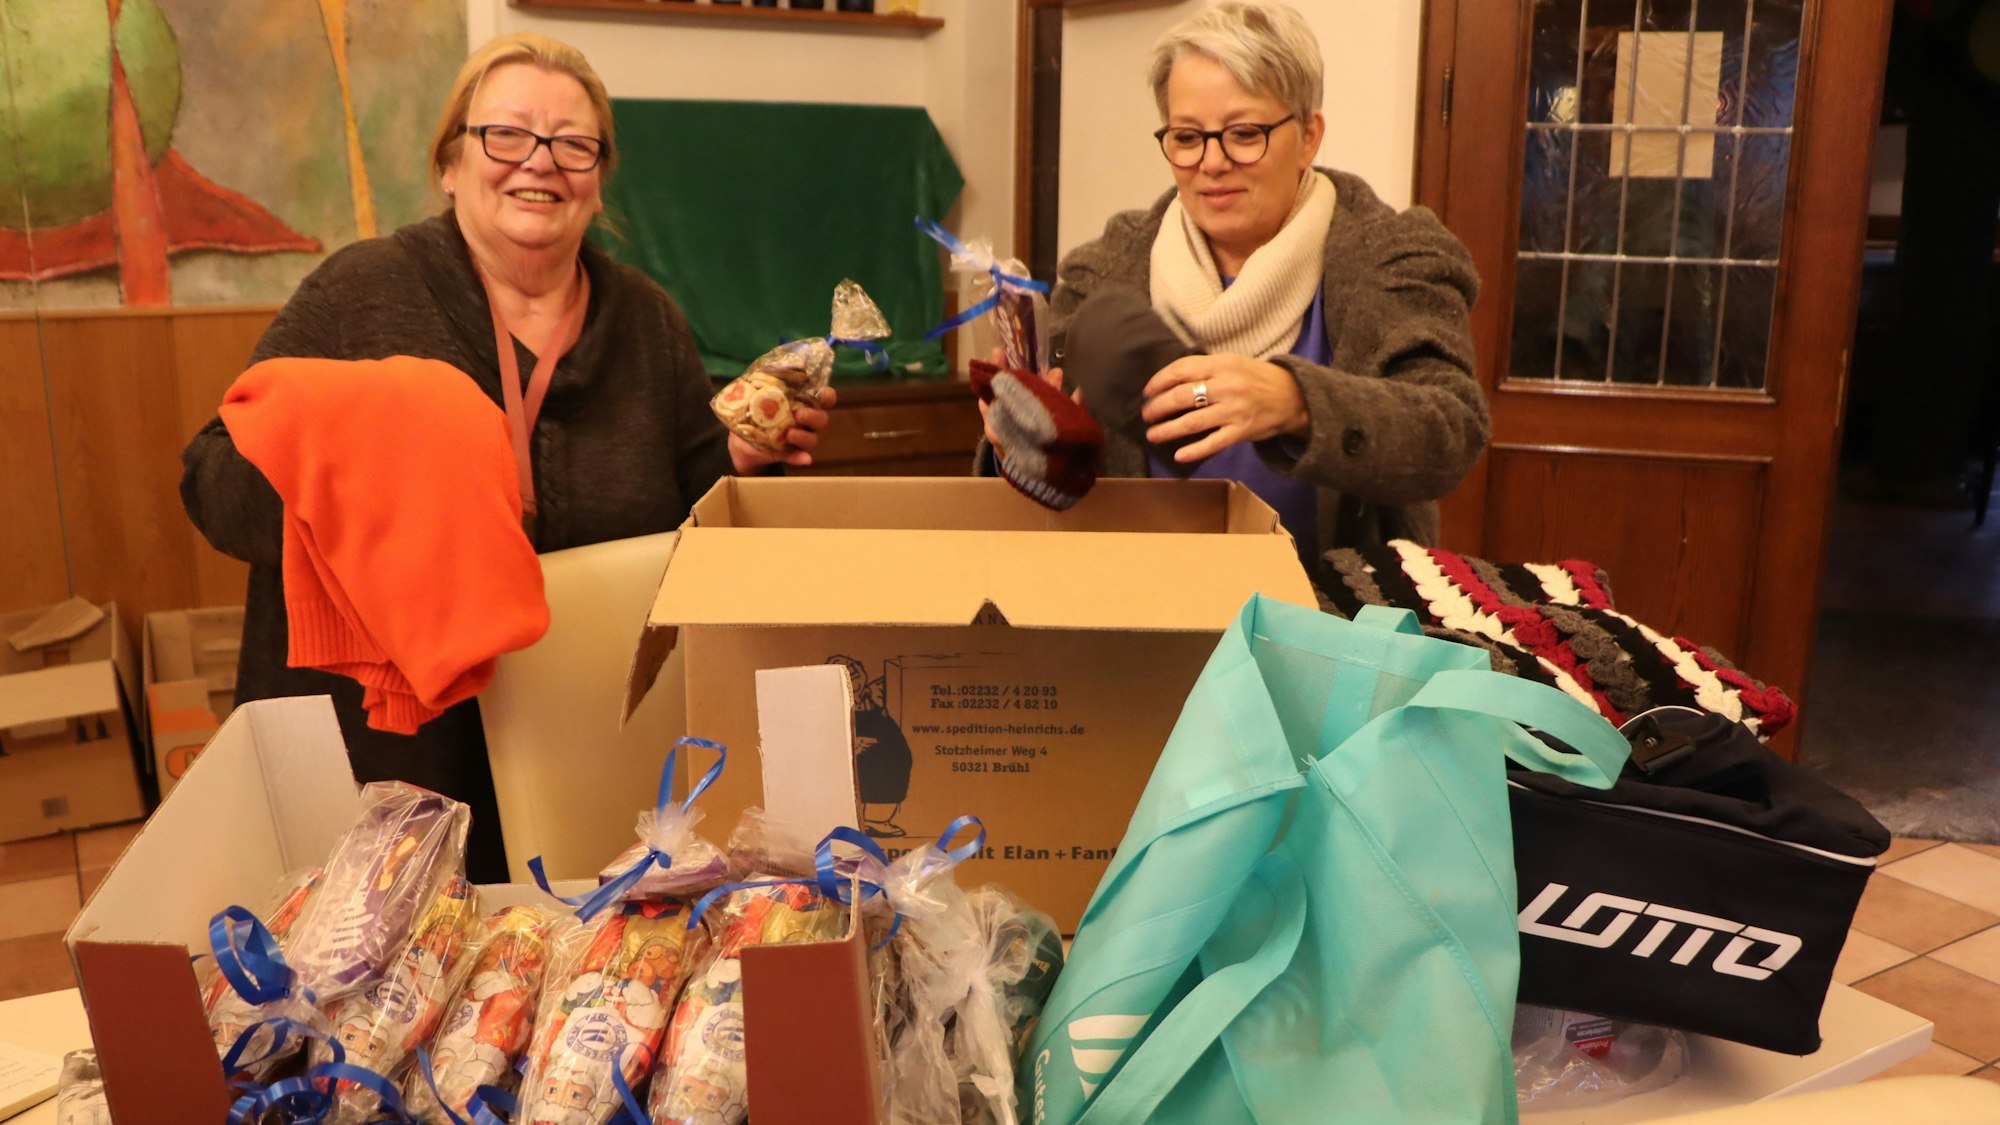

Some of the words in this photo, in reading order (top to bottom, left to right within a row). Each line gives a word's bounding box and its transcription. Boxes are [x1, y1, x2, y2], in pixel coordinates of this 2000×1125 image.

[930, 685, 999, 696] Tel.:02232
[1002, 685, 1010, 697] /
[1012, 686, 1021, 696] 4
[1024, 686, 1039, 696] 20
[1042, 686, 1057, 696] 93
[930, 699, 954, 709] Fax
[1003, 699, 1010, 710] /
[1013, 699, 1021, 710] 4
[1024, 699, 1039, 710] 82
[1043, 699, 1058, 710] 10
[912, 723, 1085, 736] www.spedition-heinrichs.de
[935, 745, 1008, 756] Stotzheimer
[1011, 746, 1036, 758] Weg
[1040, 746, 1048, 756] 4
[952, 762, 988, 773] 50321
[992, 762, 1030, 773] Brühl
[1004, 846, 1050, 860] Elan
[1055, 849, 1066, 860] +
[1517, 883, 1803, 981] LOTTO
[1034, 1049, 1051, 1125] Gutes
